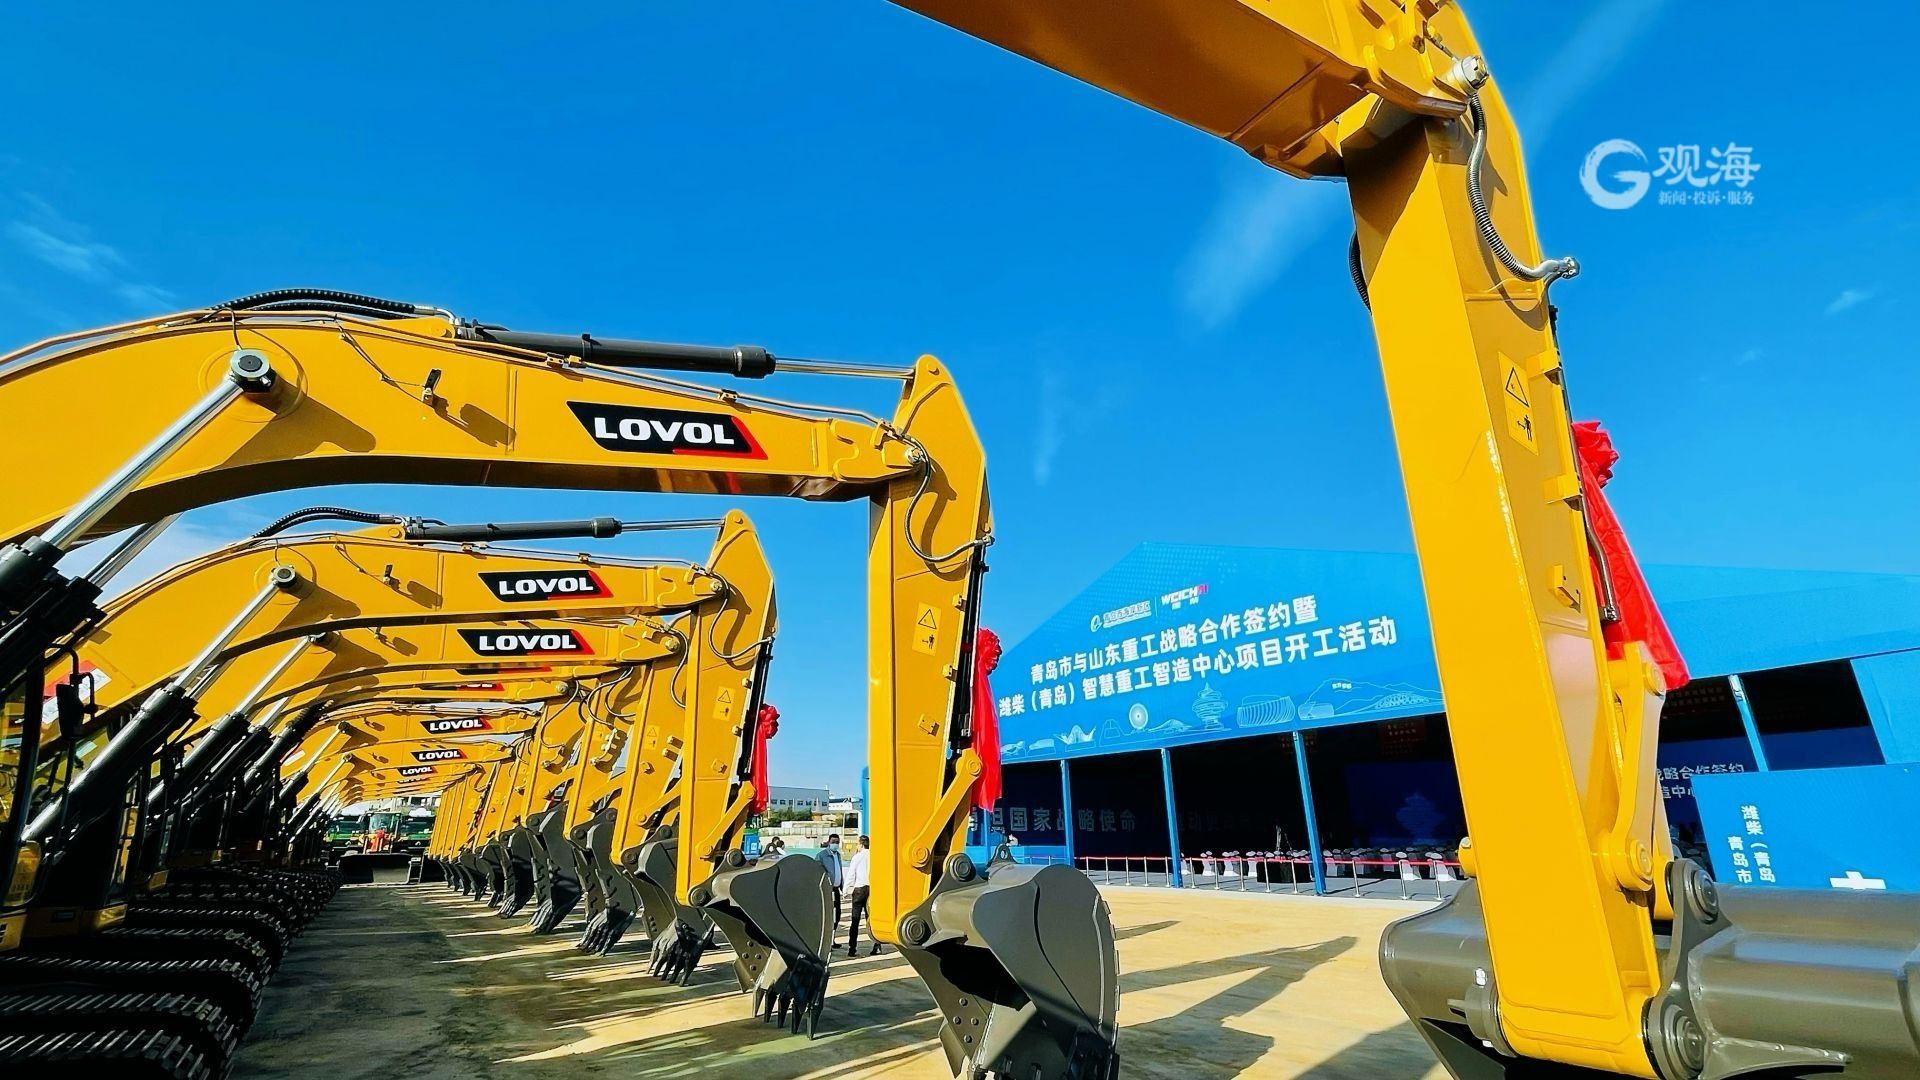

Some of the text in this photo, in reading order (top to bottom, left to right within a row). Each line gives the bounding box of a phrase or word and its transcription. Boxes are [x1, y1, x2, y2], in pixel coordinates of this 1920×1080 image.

[594, 417, 735, 445] LOVOL
[499, 577, 594, 596] LOVOL
[479, 634, 577, 651] LOVOL
[1030, 594, 1319, 685] 青岛市与山东重工战略合作签约暨
[429, 719, 483, 732] LOVOL
[418, 750, 461, 761] LOVOL
[402, 765, 433, 775] LOVOL
